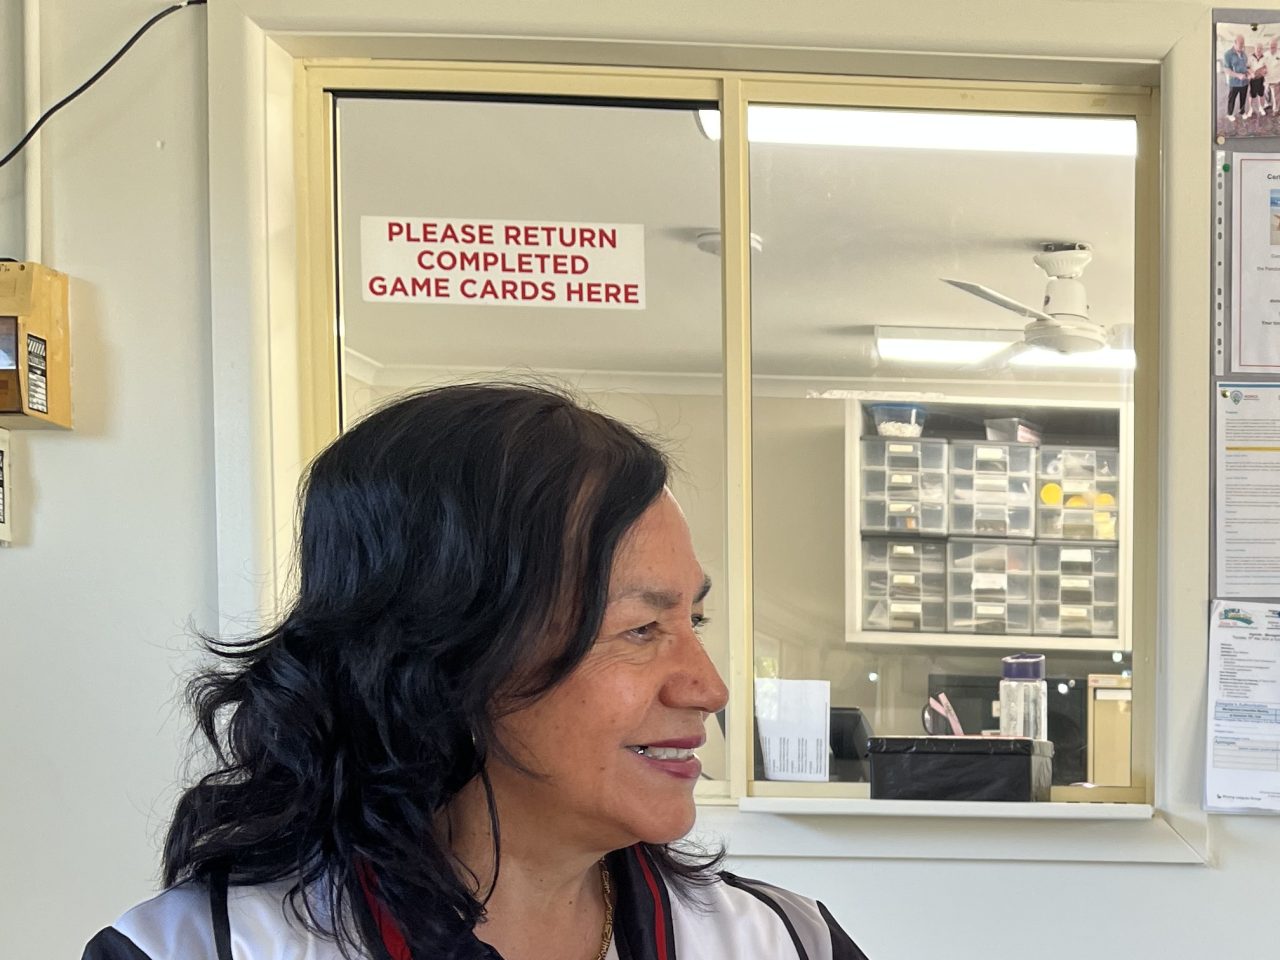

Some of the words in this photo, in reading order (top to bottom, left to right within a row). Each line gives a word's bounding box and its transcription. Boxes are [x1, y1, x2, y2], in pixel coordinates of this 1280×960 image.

[388, 222, 494, 244] PLEASE
[504, 226, 617, 248] RETURN
[417, 250, 589, 275] COMPLETED
[368, 276, 450, 297] GAME
[460, 279, 556, 301] CARDS
[566, 282, 640, 304] HERE
